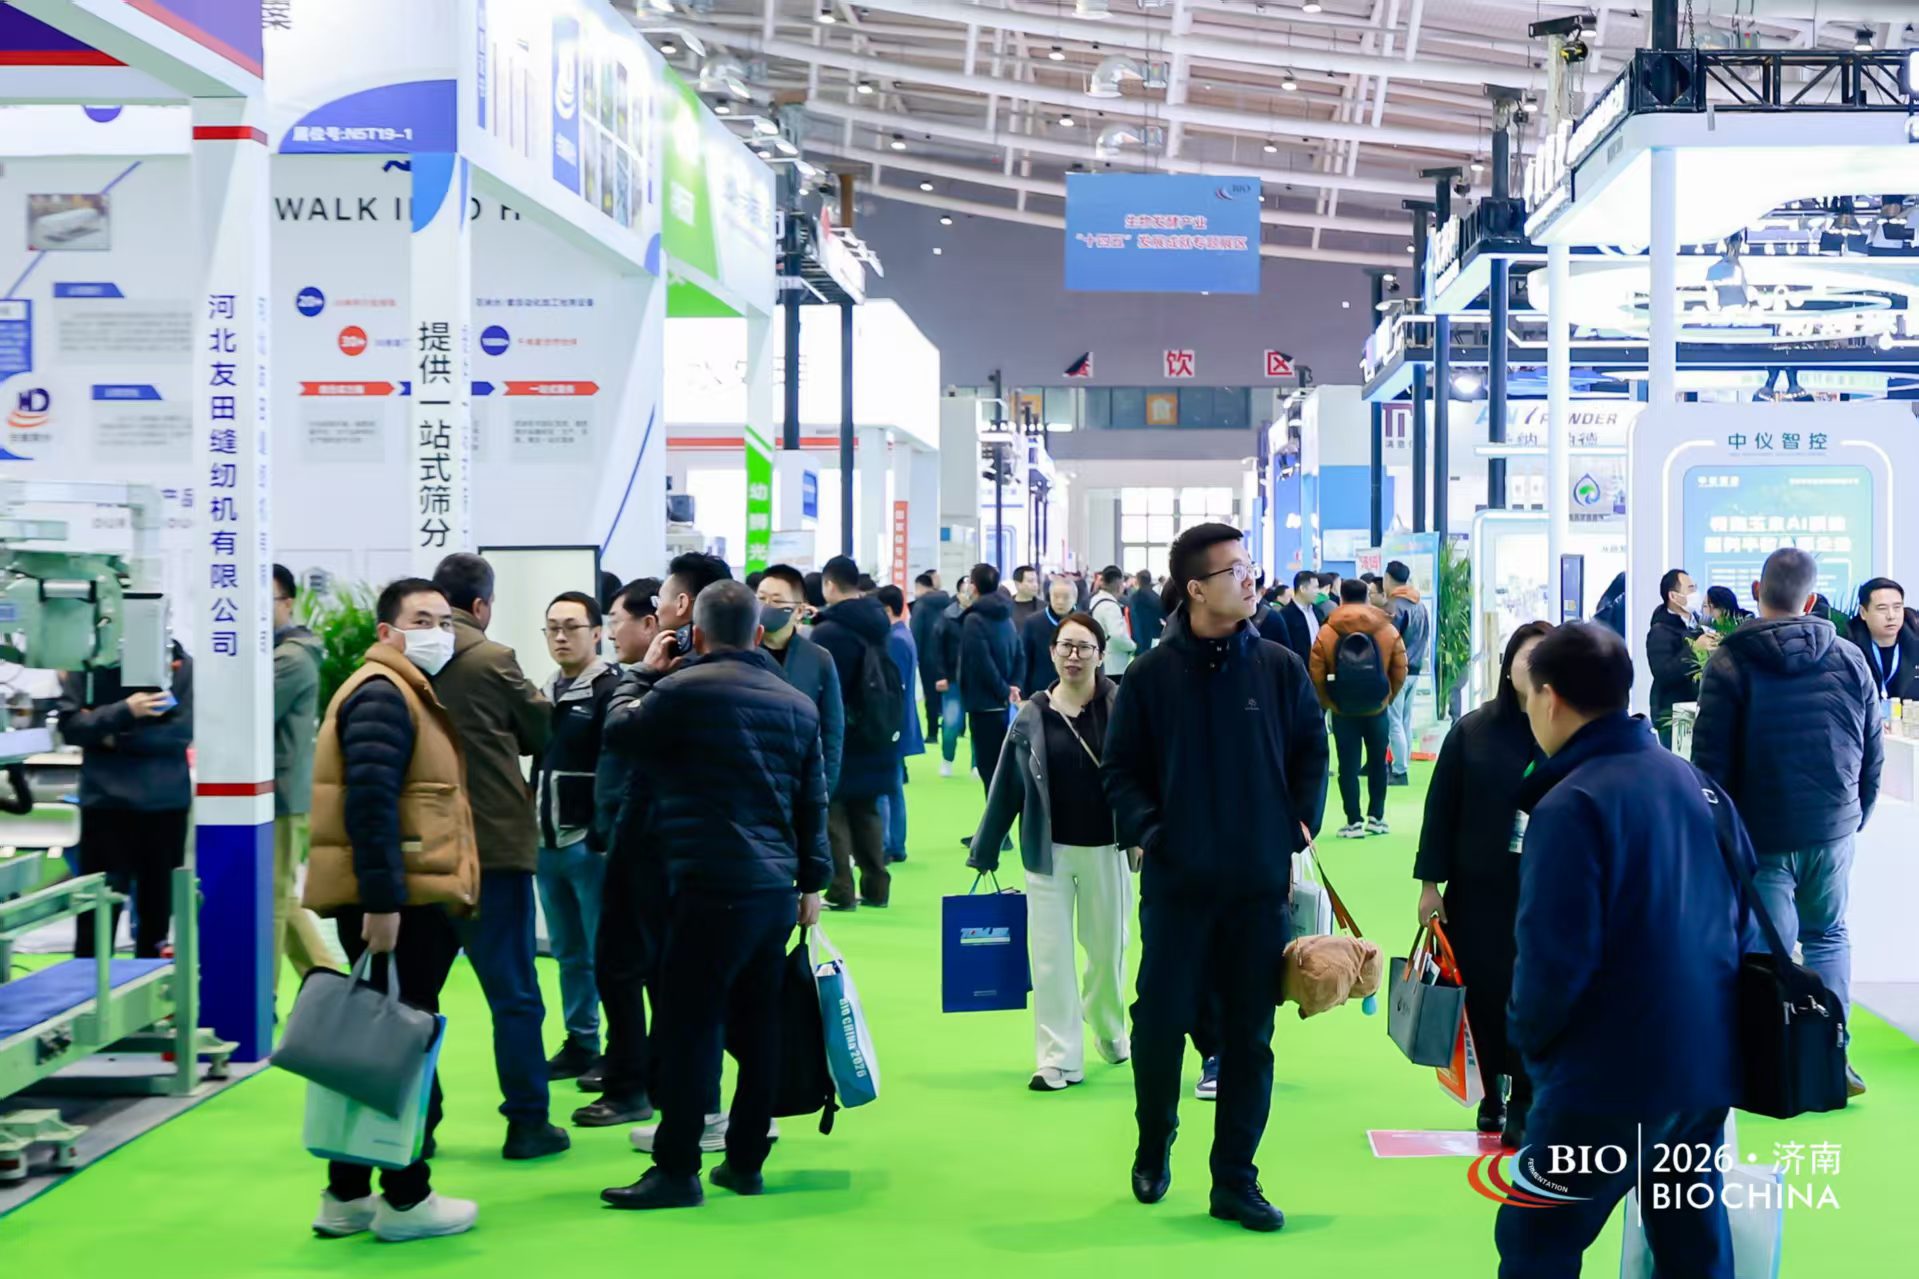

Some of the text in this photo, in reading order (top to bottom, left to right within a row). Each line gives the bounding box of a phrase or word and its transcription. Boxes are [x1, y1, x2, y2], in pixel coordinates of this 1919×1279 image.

[274, 197, 378, 222] WALK
[1166, 350, 1194, 377] 饮
[419, 321, 451, 548] 提供一站式筛分
[1728, 432, 1828, 450] 中仪智控
[208, 294, 238, 657] 河北友田缝纫机有限公司
[850, 1050, 867, 1078] 2026
